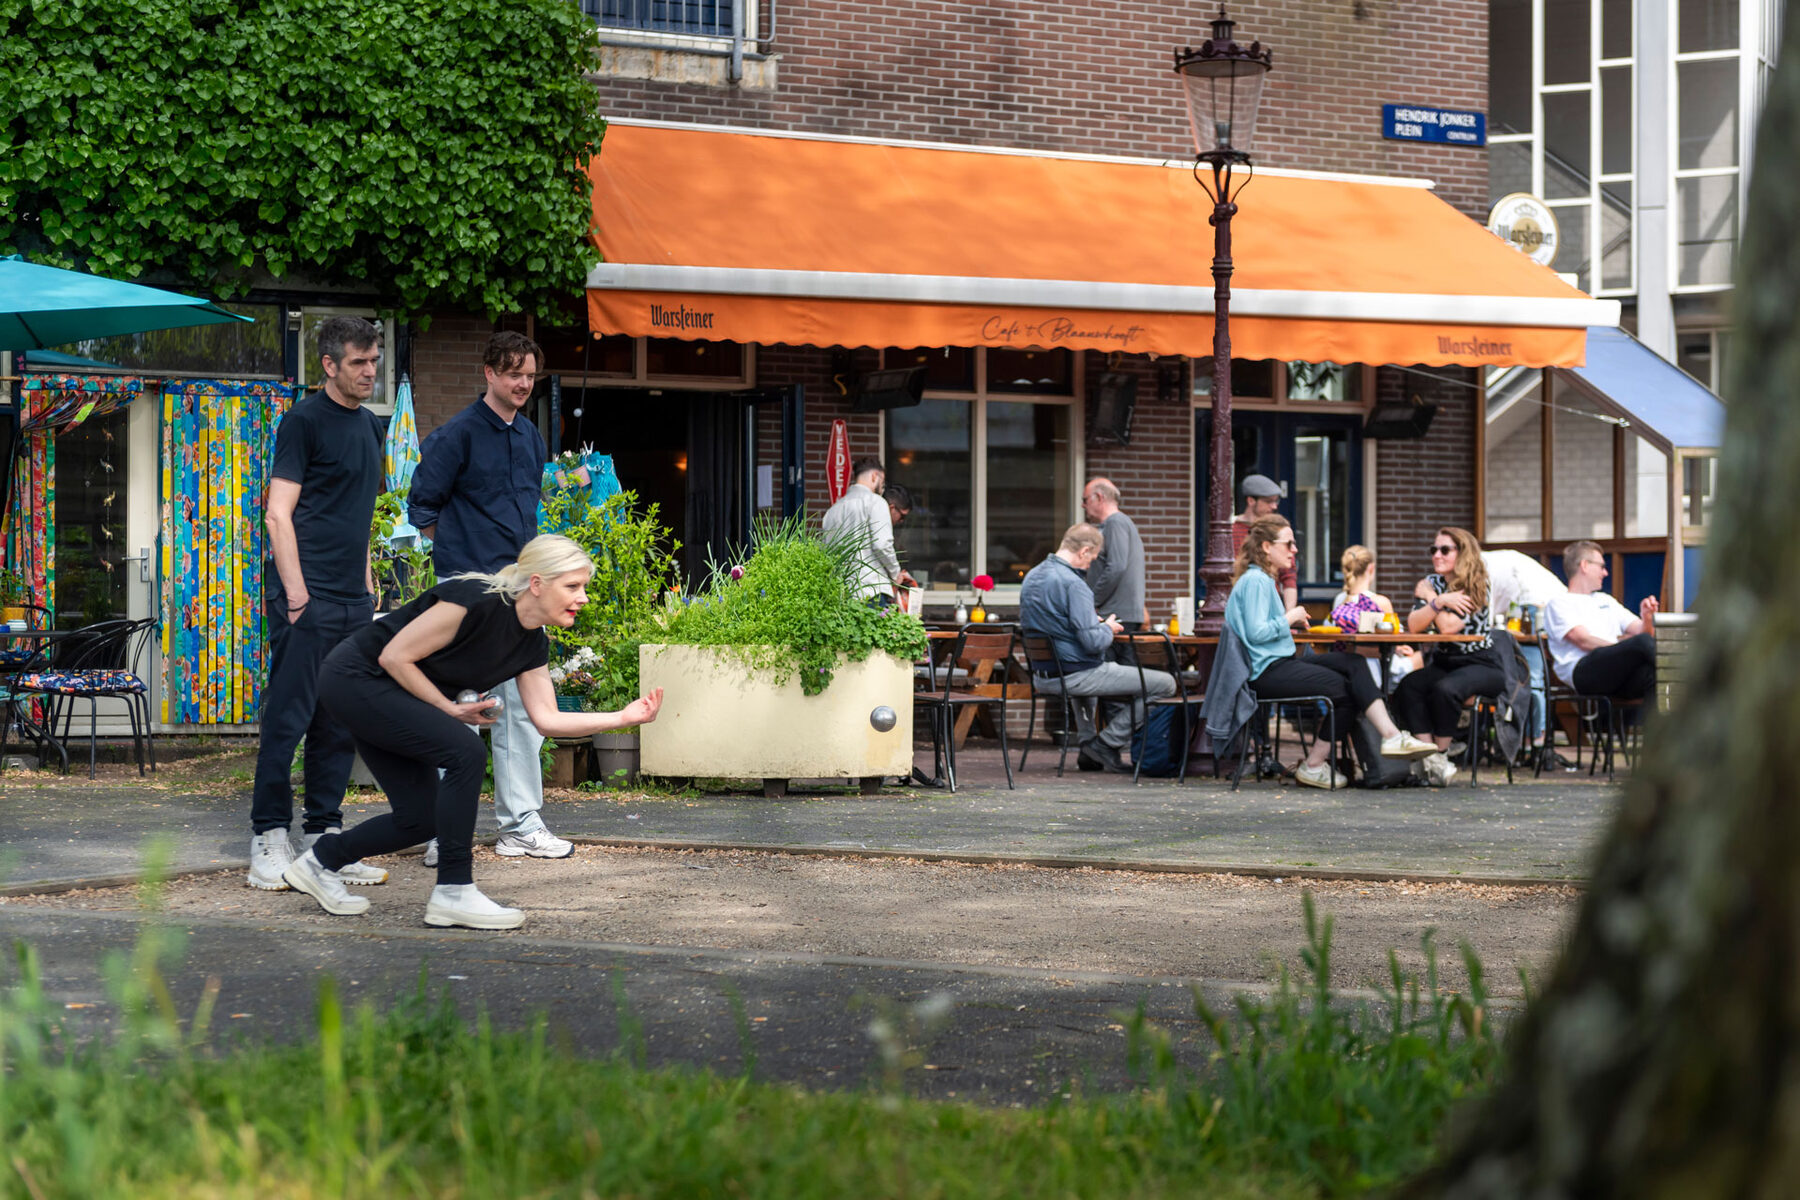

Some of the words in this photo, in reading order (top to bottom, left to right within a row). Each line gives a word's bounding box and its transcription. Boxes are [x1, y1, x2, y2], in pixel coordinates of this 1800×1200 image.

[1394, 108, 1439, 124] HENDRIK
[1439, 112, 1477, 128] JONKER
[1394, 123, 1423, 137] PLEIN
[1497, 223, 1554, 247] Warsteiner
[650, 303, 714, 331] Warsteiner
[1437, 335, 1513, 358] Warsteiner
